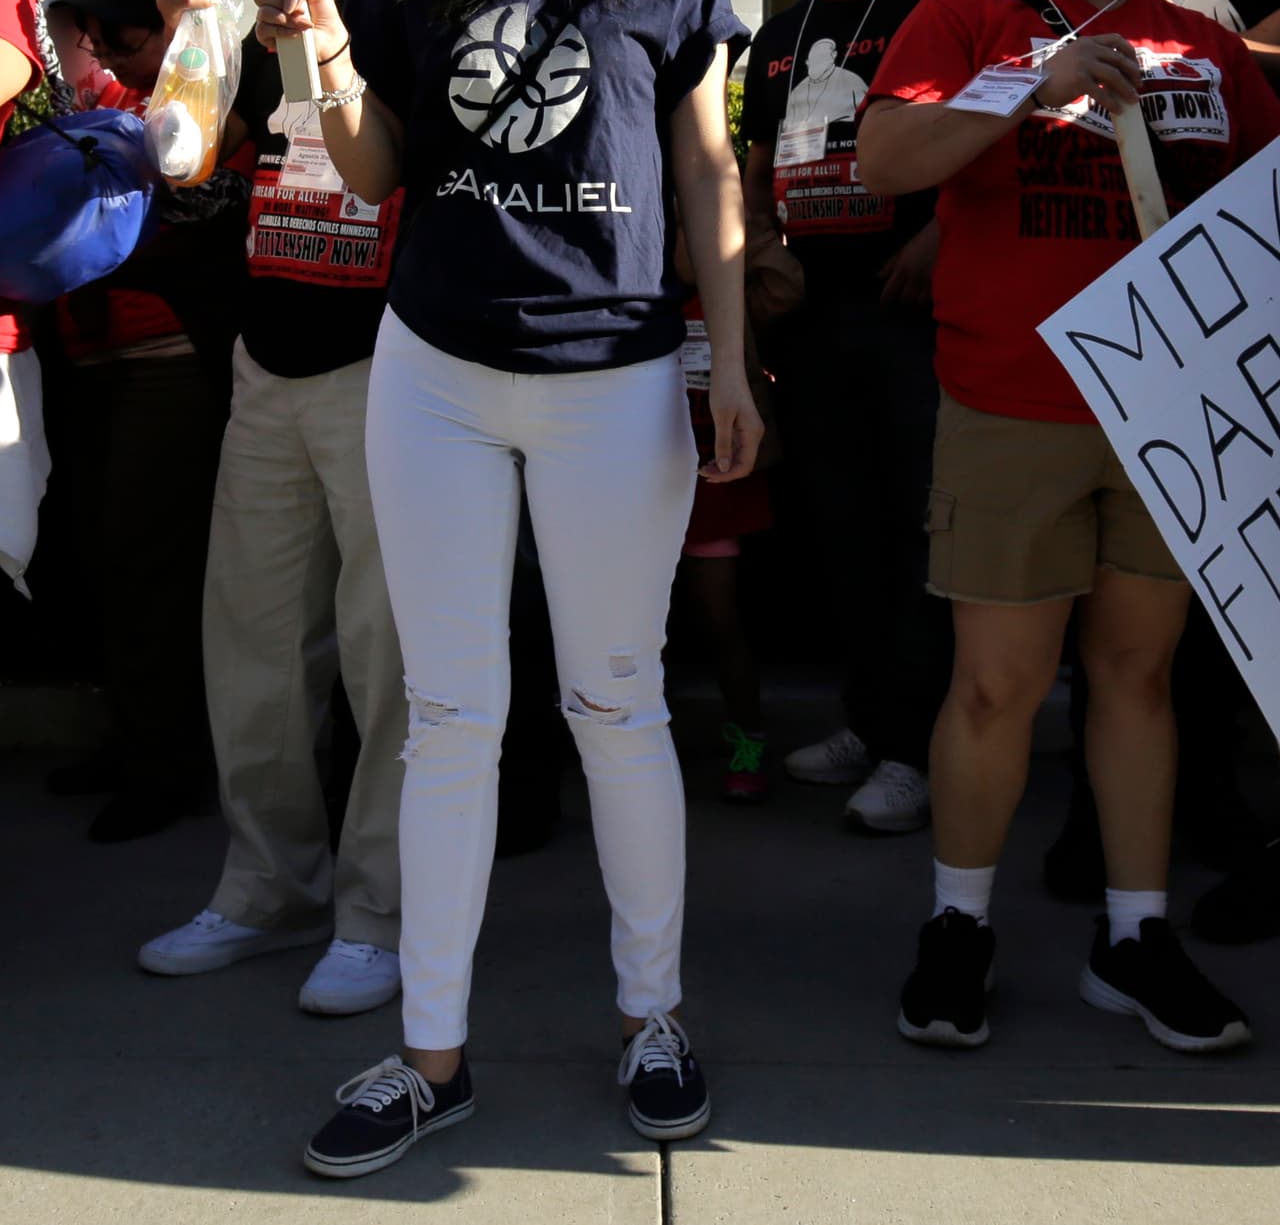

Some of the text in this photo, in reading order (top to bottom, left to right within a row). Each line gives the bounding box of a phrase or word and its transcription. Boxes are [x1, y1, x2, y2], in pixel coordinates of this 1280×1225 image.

[1174, 93, 1219, 119] NOW!
[277, 189, 328, 205] FOR ALL!!!
[1021, 191, 1109, 241] NEITHER
[255, 229, 377, 267] CITIZENSHIP NOW!
